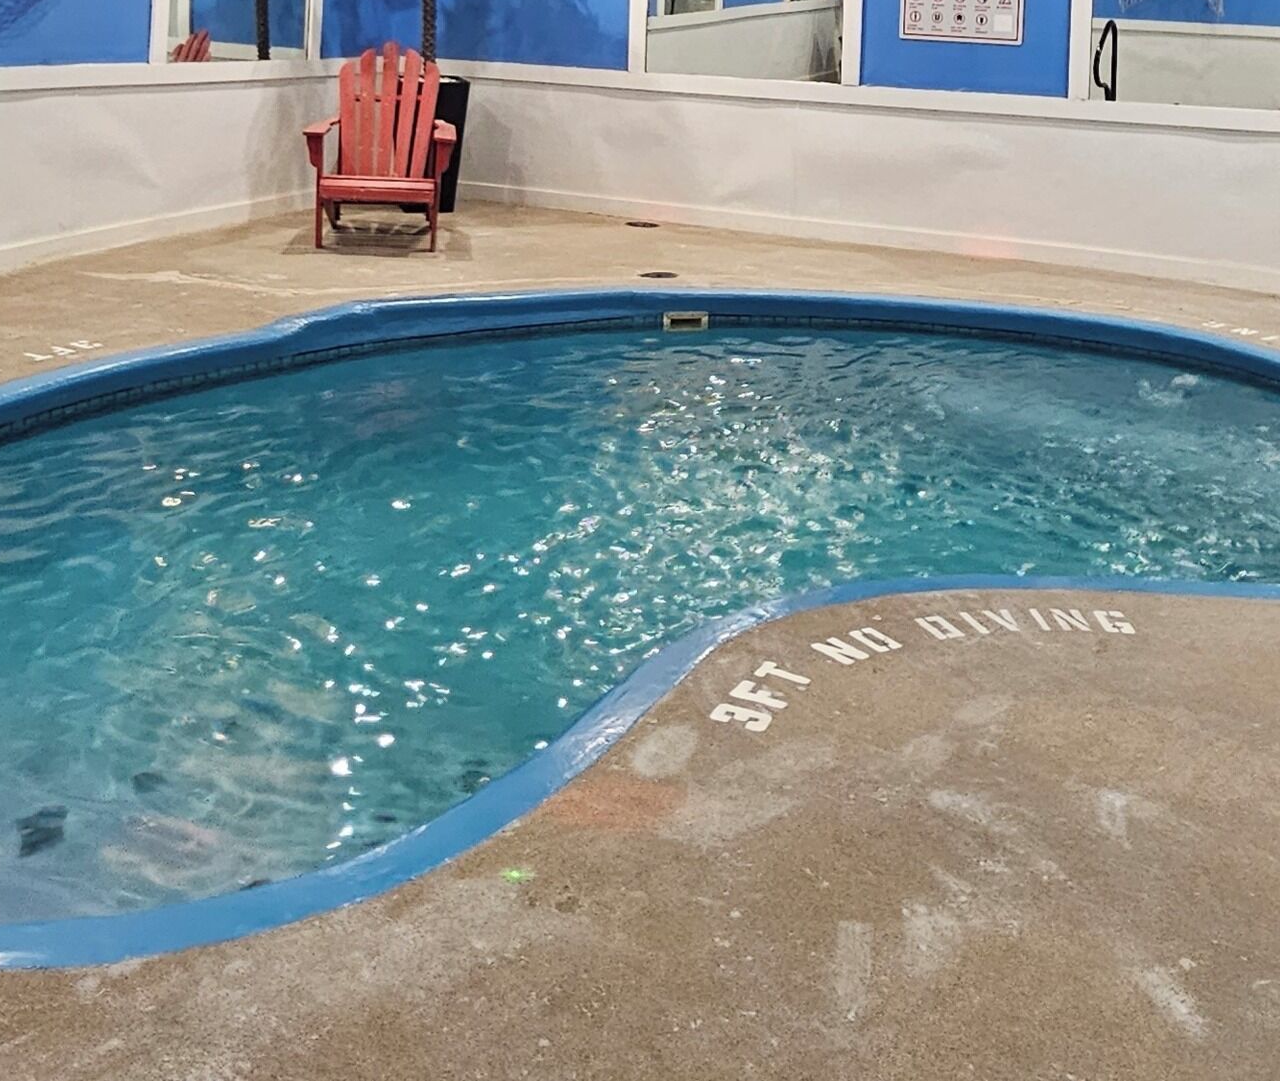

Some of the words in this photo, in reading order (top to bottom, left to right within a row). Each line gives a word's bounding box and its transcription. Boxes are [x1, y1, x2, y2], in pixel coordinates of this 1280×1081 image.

[709, 660, 812, 732] 3FT
[810, 626, 904, 666] NO
[914, 607, 1136, 641] DIVING
